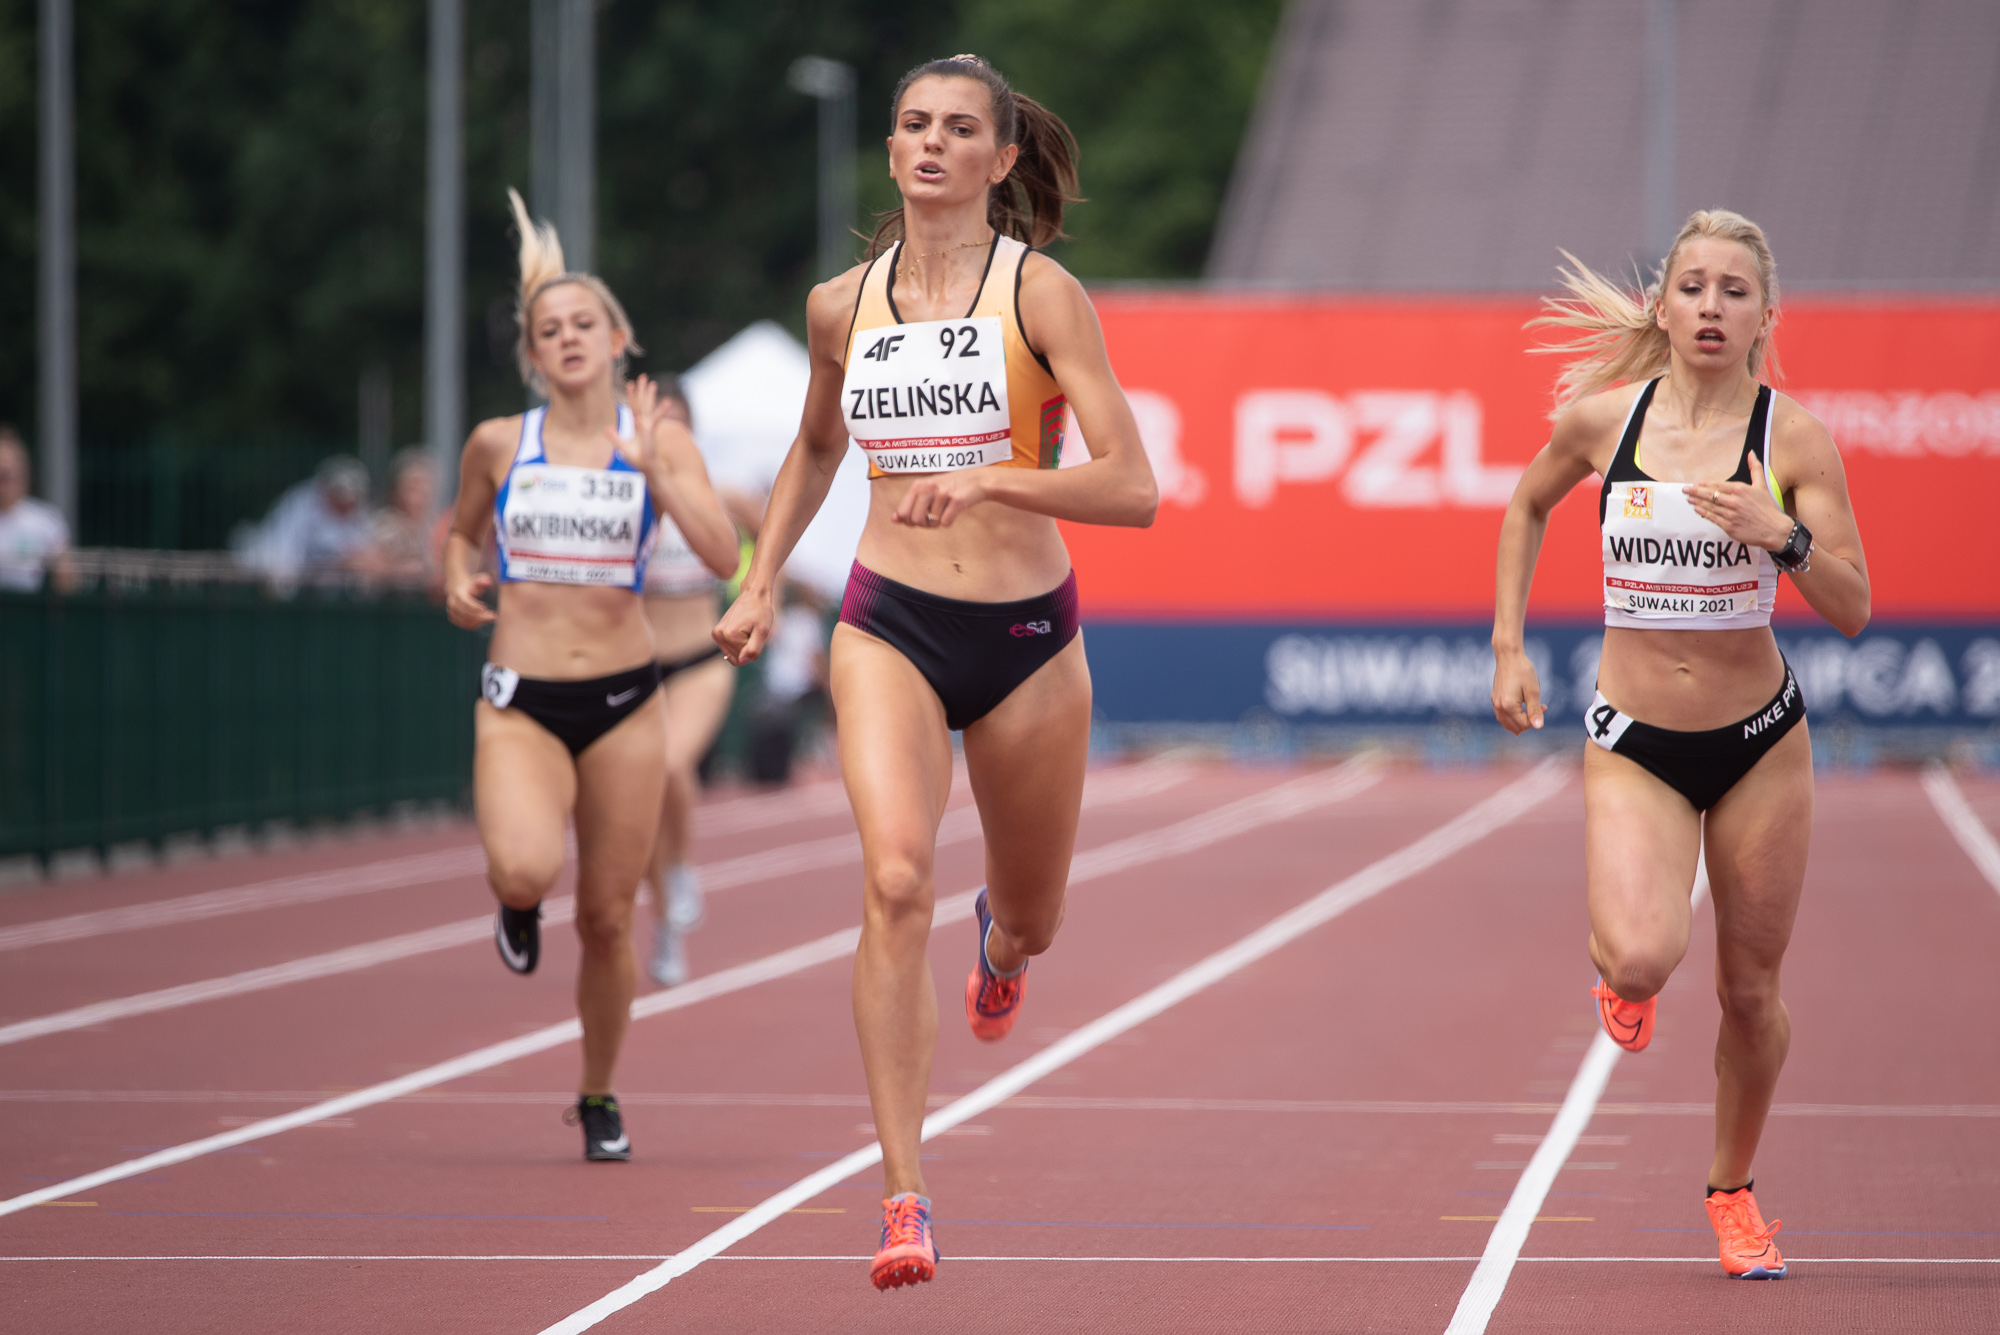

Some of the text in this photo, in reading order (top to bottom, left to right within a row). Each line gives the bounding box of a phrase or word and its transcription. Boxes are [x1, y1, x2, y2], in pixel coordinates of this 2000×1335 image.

[939, 325, 980, 360] 92
[850, 378, 1001, 420] ZIELIŃSKA
[891, 437, 951, 448] MISTRZOSTWA
[952, 435, 984, 446] POLSKI
[985, 432, 1005, 442] U23
[1233, 388, 1606, 509] PZL
[876, 450, 984, 469] SUWAŁKI 2021
[581, 474, 633, 501] 338
[510, 509, 633, 541] SKIBIŃSKA
[1609, 535, 1752, 568] WIDAWSKA
[1625, 581, 1645, 590] PZLA
[1646, 584, 1705, 593] MISTRZOSTWA
[1706, 585, 1735, 594] POLSKI
[1736, 582, 1753, 591] U23
[1629, 595, 1734, 613] SUWAŁKI 2021
[1592, 704, 1619, 740] 4
[1743, 702, 1785, 740] NIKE
